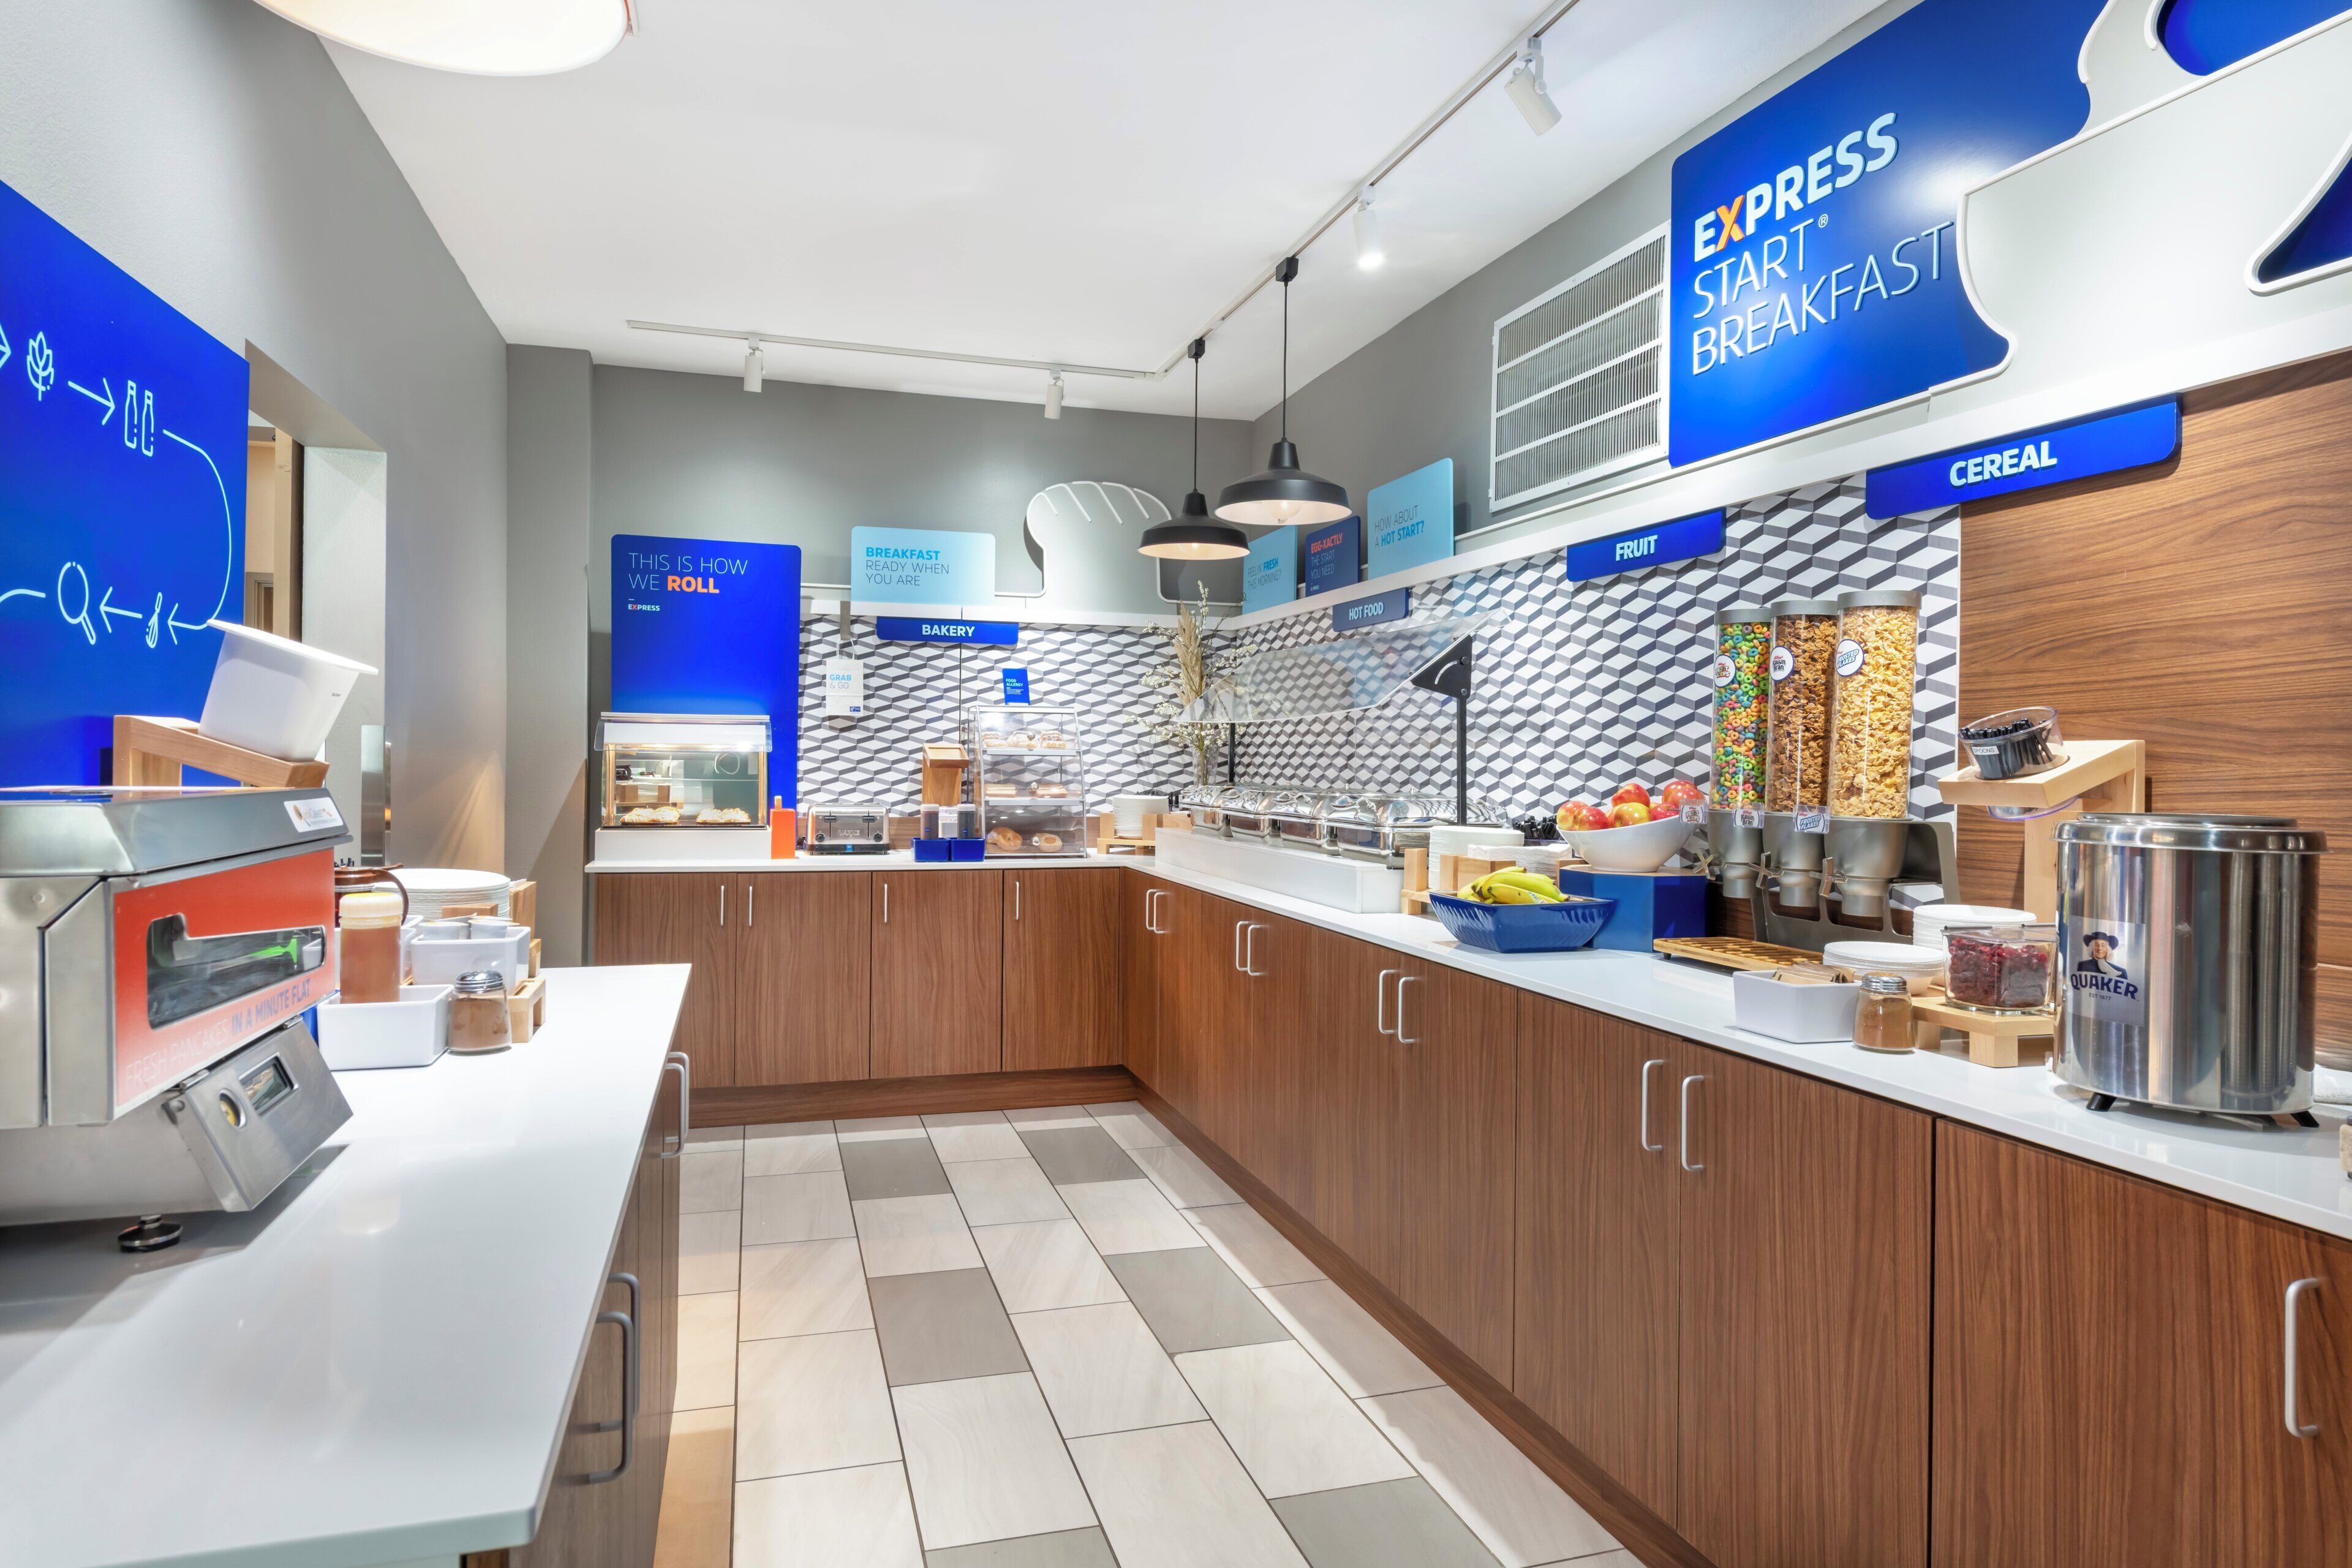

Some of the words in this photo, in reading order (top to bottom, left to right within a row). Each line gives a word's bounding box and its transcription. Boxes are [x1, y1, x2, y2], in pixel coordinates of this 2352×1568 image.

[1694, 113, 1898, 263] EXPRESS
[1692, 221, 1954, 376] BREAKFAST
[1950, 440, 2057, 488] CEREAL
[1374, 515, 1392, 533] HOW
[1393, 505, 1419, 525] ABOUT
[1311, 533, 1343, 554] EGG-XACTLY
[1374, 537, 1380, 549] A
[1381, 531, 1396, 546] HOT
[1398, 521, 1425, 541] START?
[865, 547, 941, 560] BREAKFAST
[1311, 555, 1320, 566] THE
[1321, 549, 1336, 564] START
[1616, 535, 1658, 561] FRUIT
[628, 552, 670, 571] THIS
[678, 556, 693, 572] IS
[701, 558, 748, 575] HOW
[865, 560, 907, 573] READY
[911, 562, 949, 575] WHEN
[1263, 557, 1279, 572] FRESH
[1310, 569, 1321, 579] YOU
[1322, 564, 1335, 577] NEED
[628, 573, 660, 590] WE
[667, 575, 720, 594] ROLL
[865, 573, 892, 585] YOU
[896, 575, 921, 586] ARE
[1248, 576, 1257, 590] THIS
[1257, 569, 1282, 587] MORNING?
[1349, 606, 1363, 621] HOT
[1364, 601, 1384, 617] FOOD
[922, 624, 975, 637] BAKERY
[2071, 973, 2138, 1000] QUAKER
[126, 1048, 167, 1091] FRESH
[170, 1019, 229, 1068] PANCAKES
[232, 1012, 243, 1036] IN
[246, 1010, 252, 1028] A
[255, 989, 289, 1021] MINUTE
[292, 978, 311, 1006] FLAT
